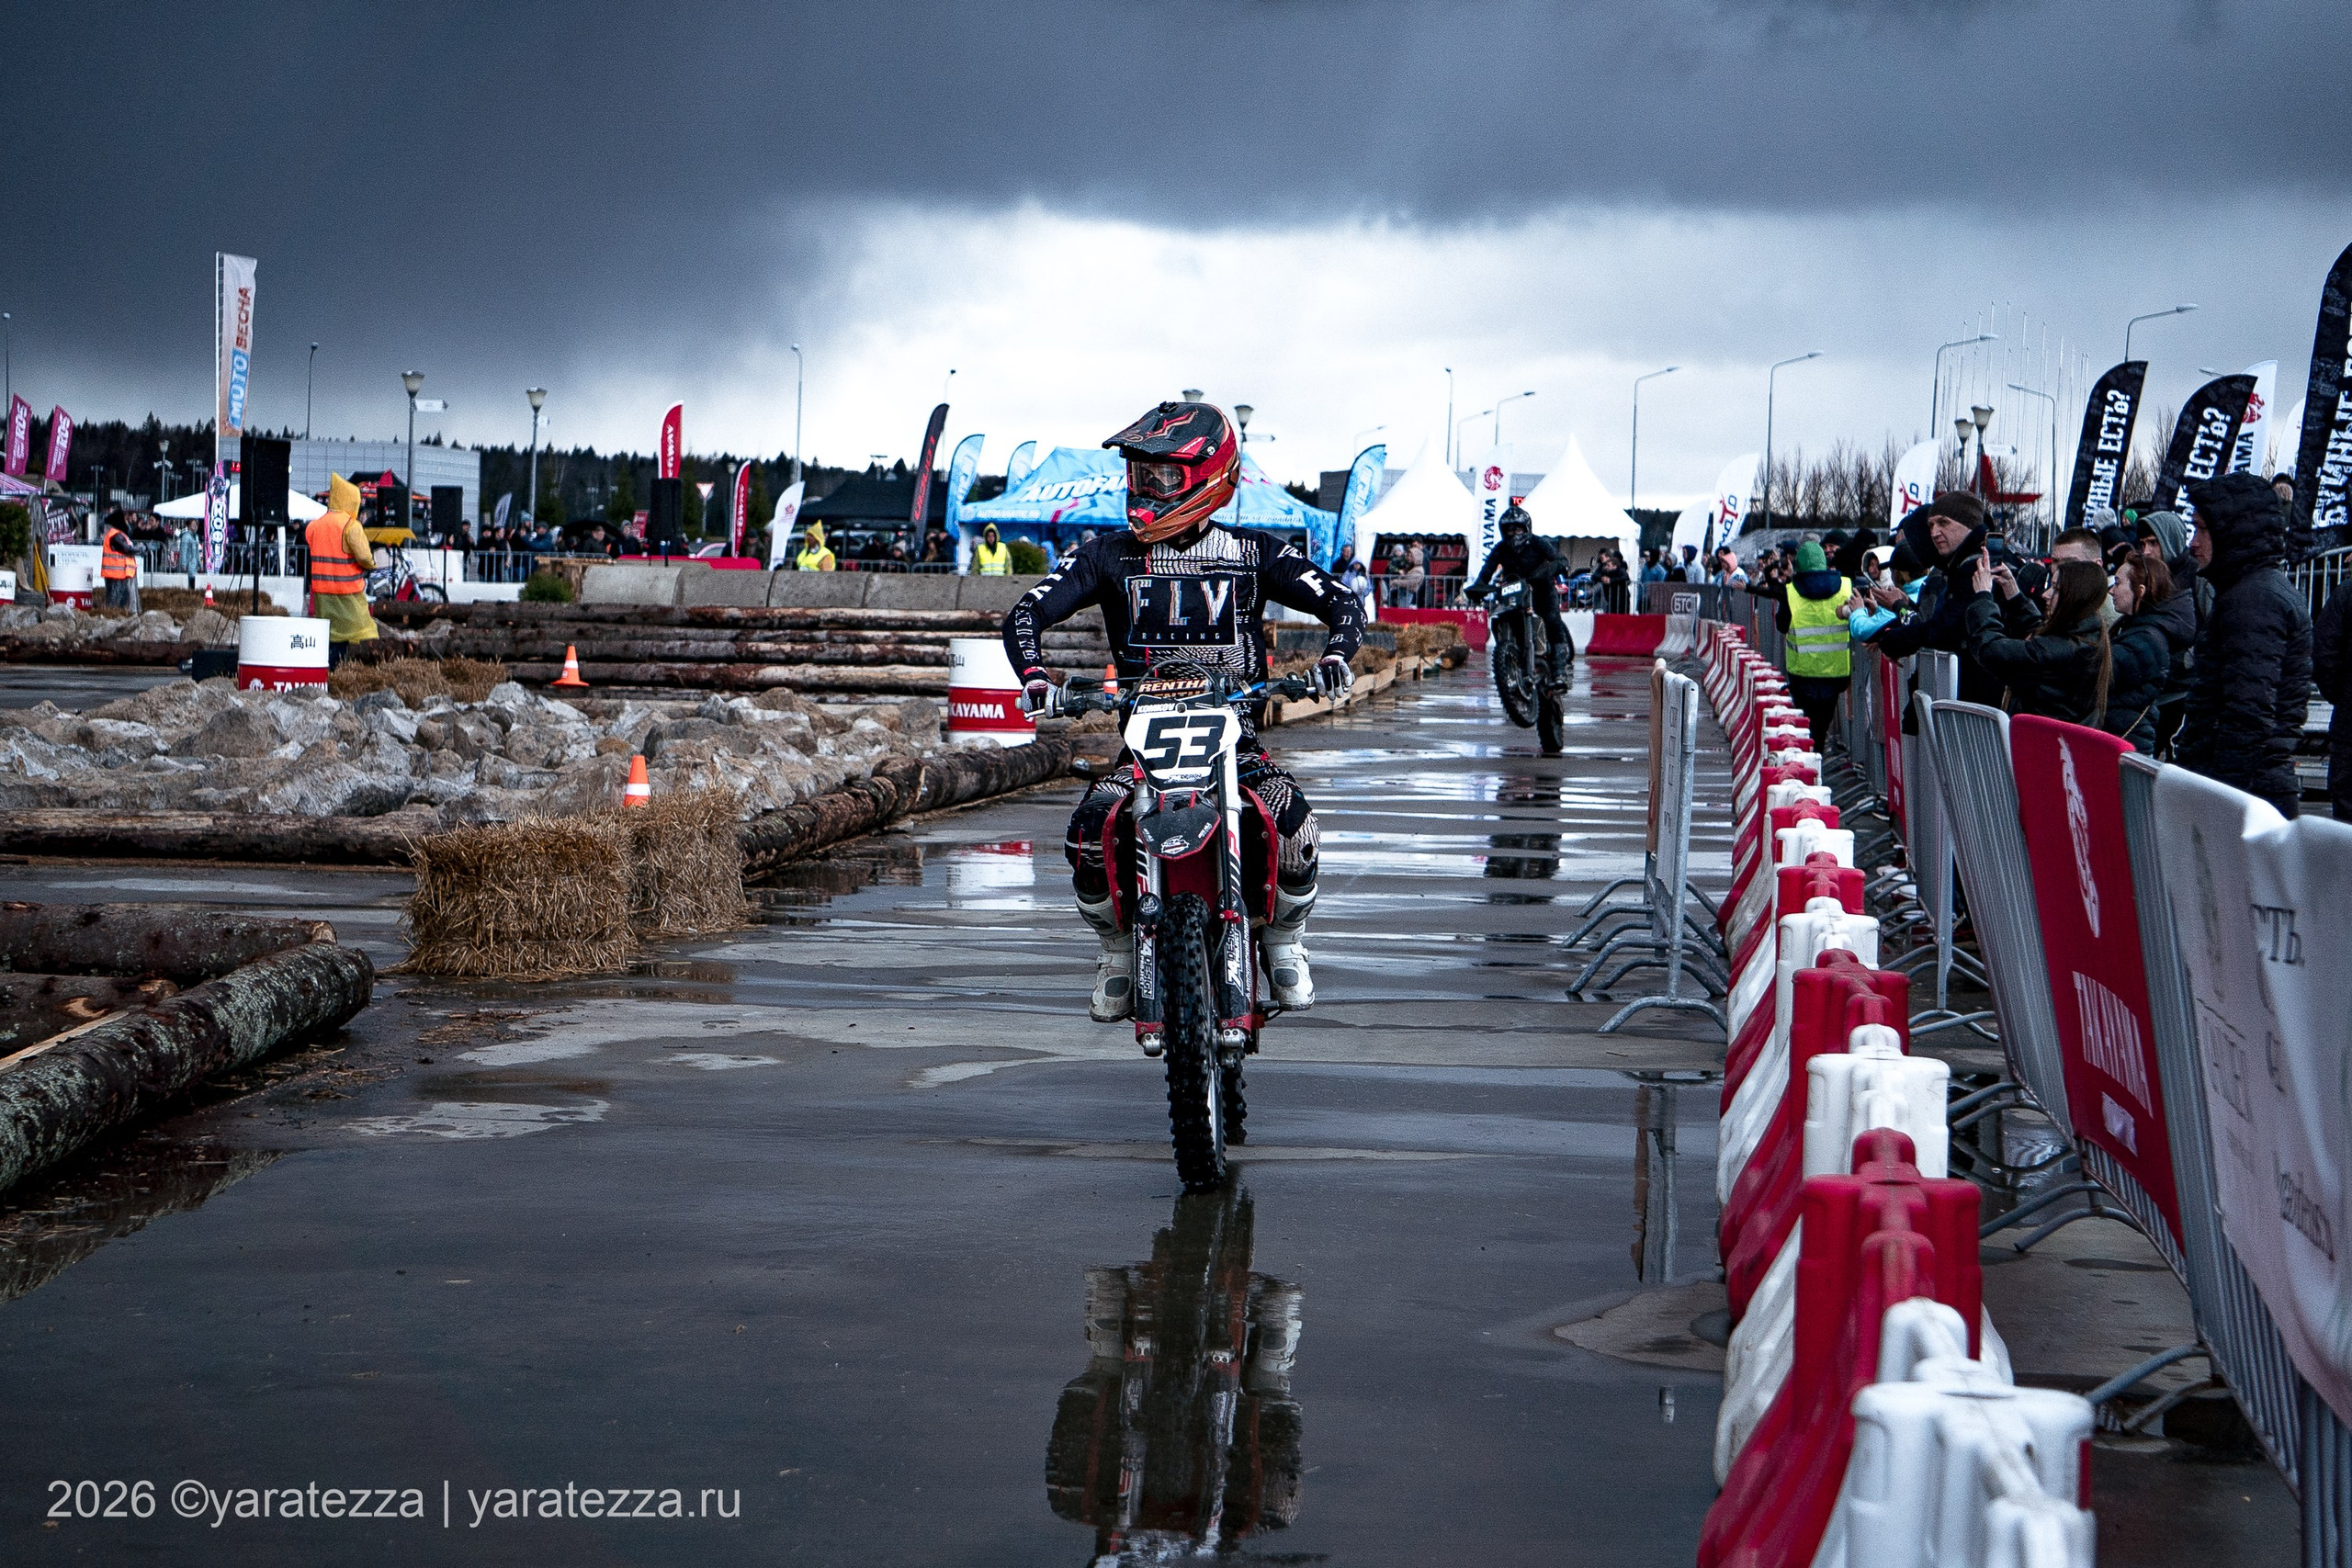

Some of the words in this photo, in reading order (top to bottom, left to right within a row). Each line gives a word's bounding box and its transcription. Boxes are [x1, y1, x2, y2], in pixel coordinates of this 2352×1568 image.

[2097, 389, 2131, 454] ЕСТЬ?
[1131, 580, 1231, 626] FLY
[290, 634, 316, 649] 高山
[1141, 632, 1220, 640] RACING
[1139, 679, 1208, 693] RENTHA
[1144, 716, 1227, 772] 53
